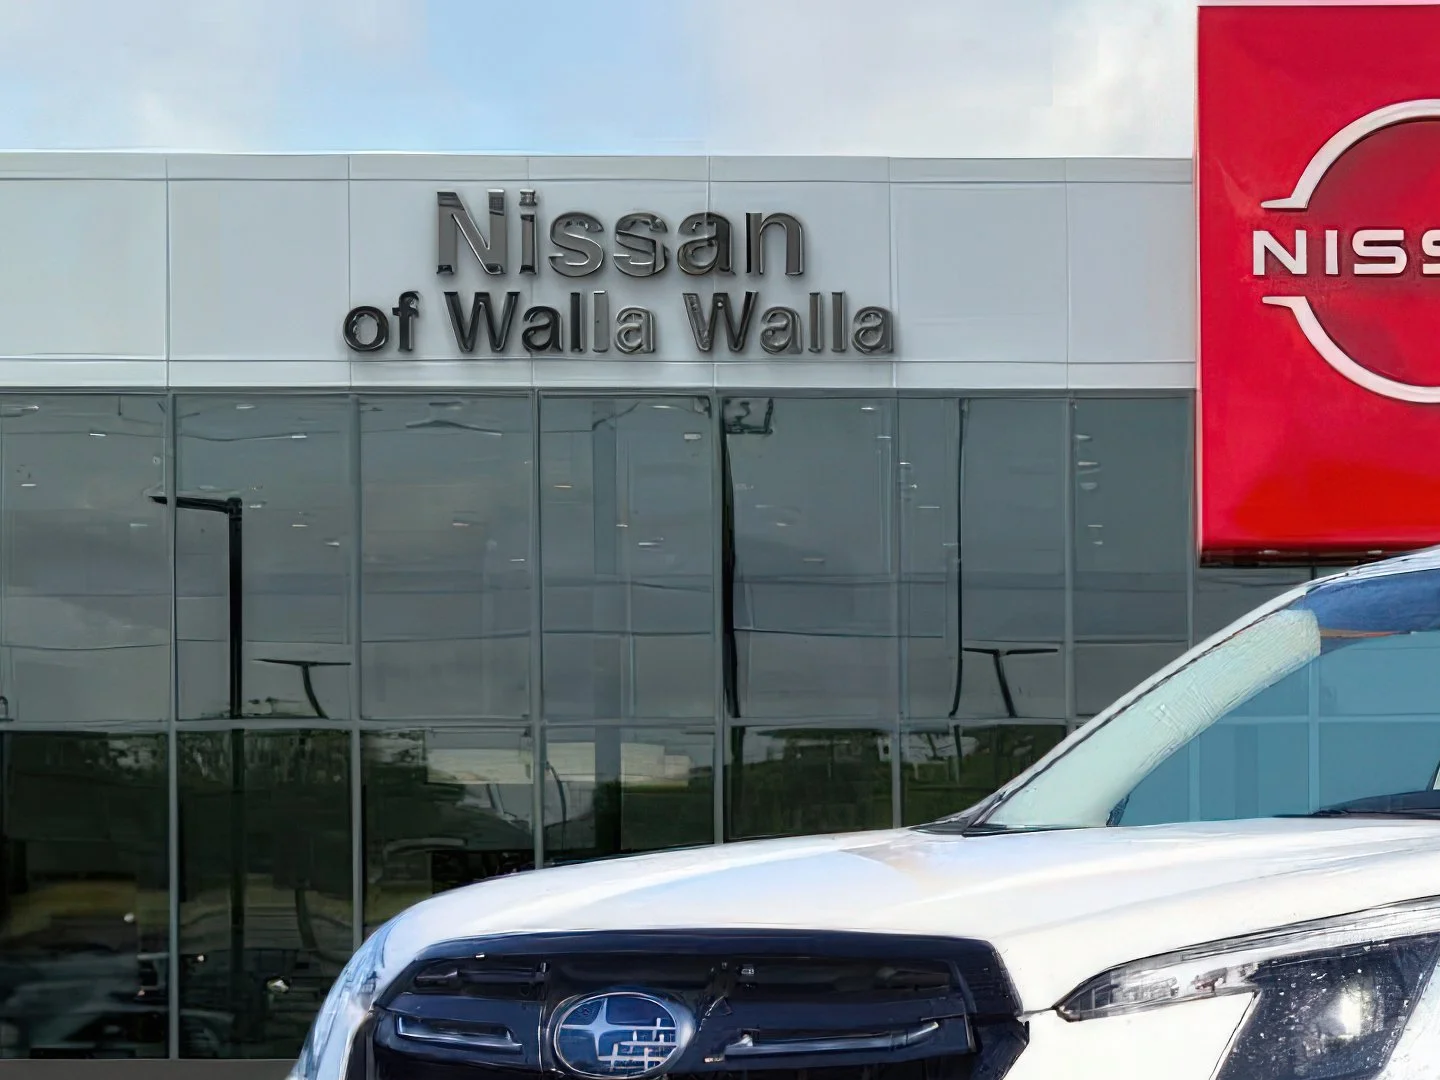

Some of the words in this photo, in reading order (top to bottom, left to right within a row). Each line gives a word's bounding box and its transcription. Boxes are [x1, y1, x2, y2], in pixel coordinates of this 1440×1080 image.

[436, 189, 804, 277] Nissan
[342, 290, 420, 353] of
[444, 290, 656, 354] Walla
[682, 290, 894, 354] Walla
